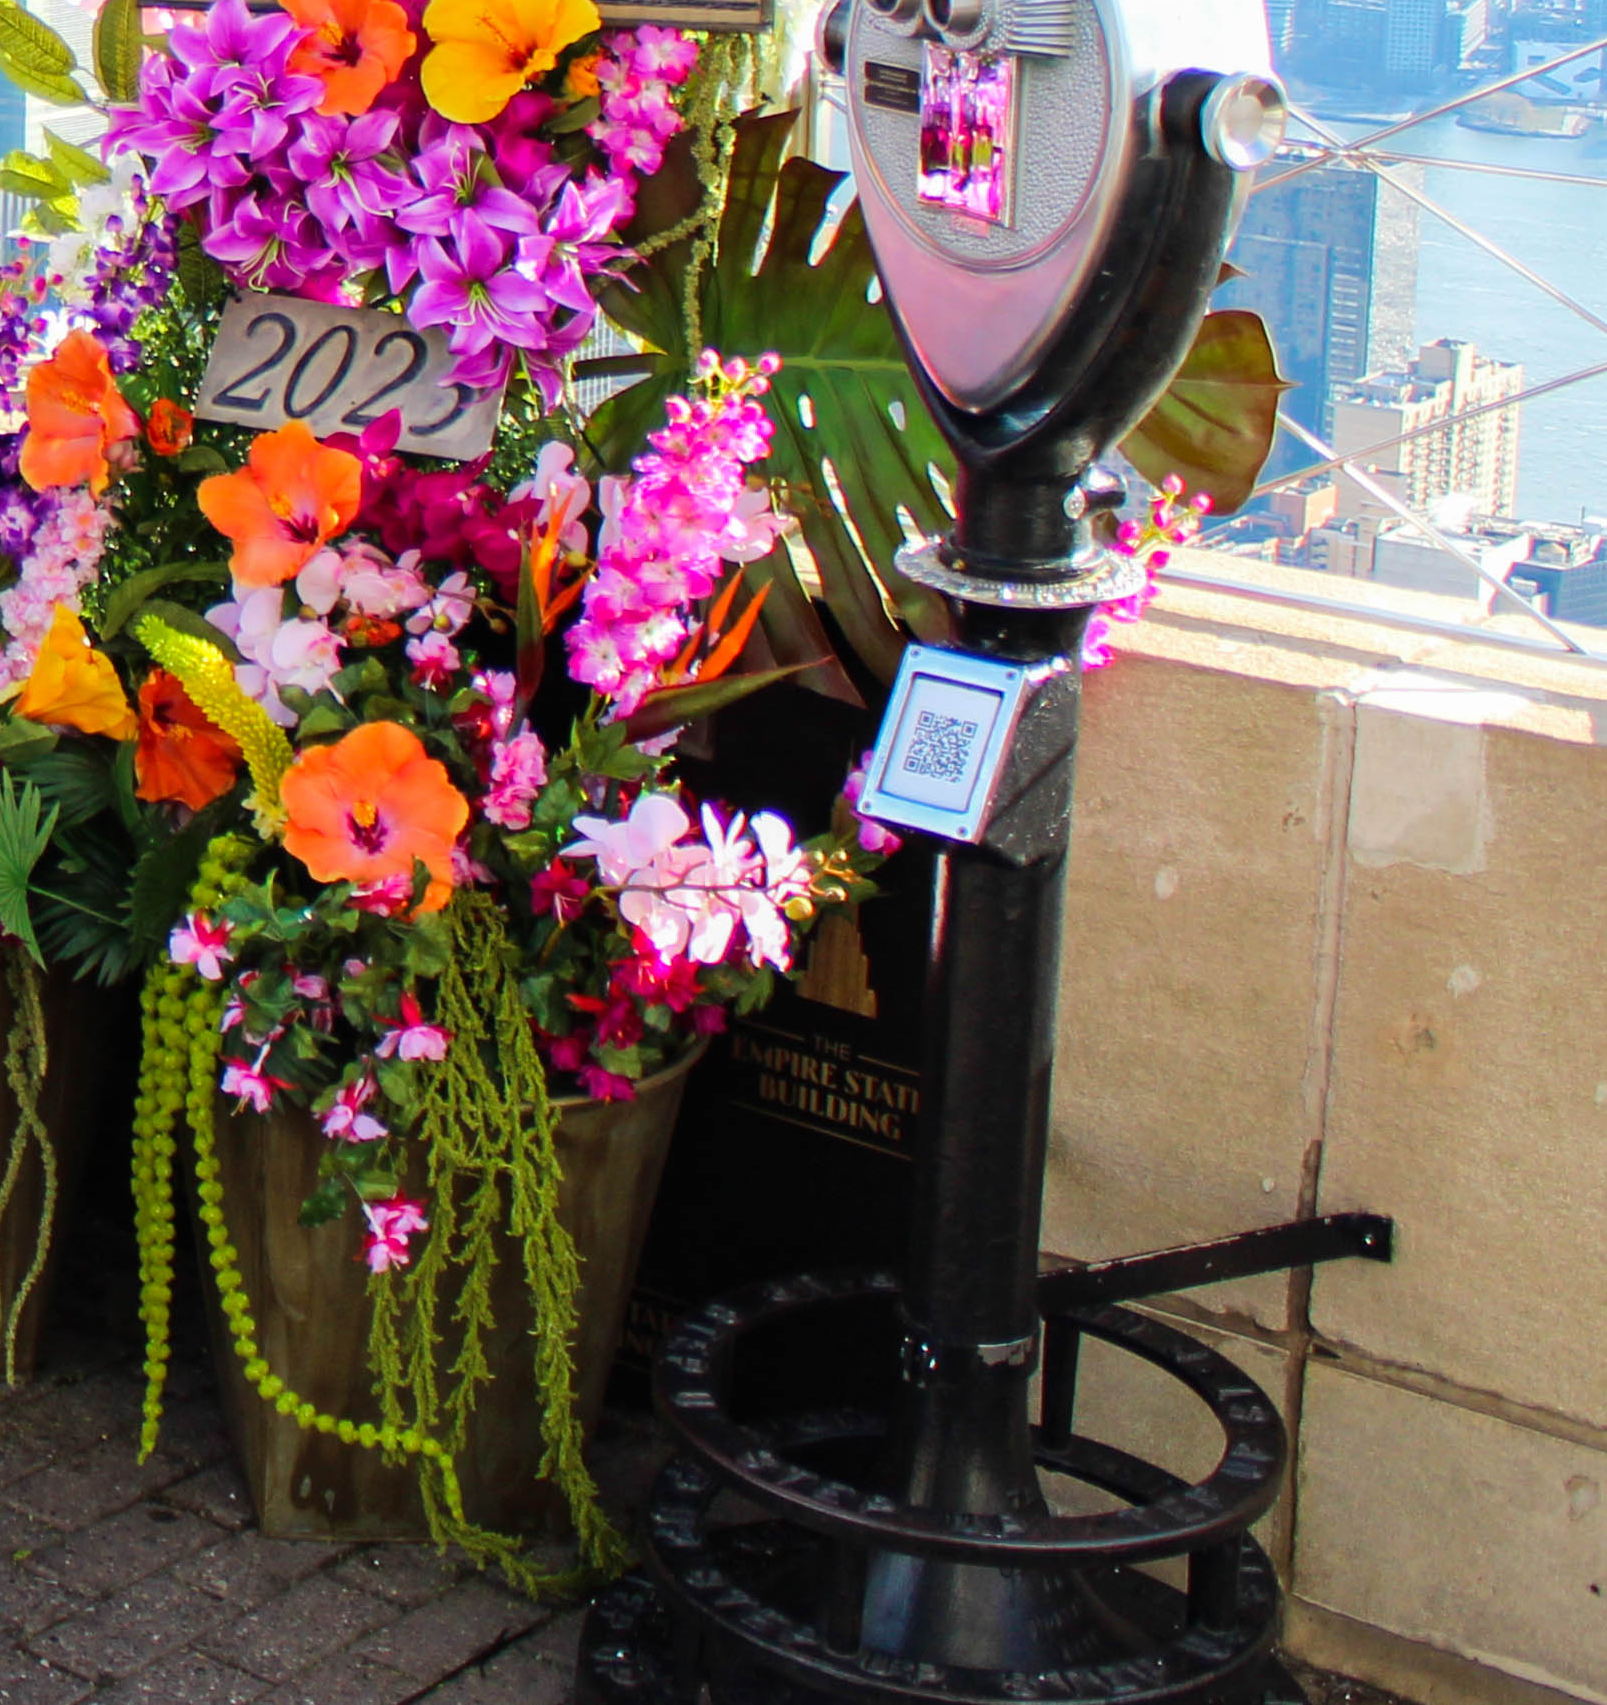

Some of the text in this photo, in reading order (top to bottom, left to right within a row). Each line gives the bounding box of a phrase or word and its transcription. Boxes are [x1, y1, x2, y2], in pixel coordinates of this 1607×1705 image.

[730, 1035, 840, 1091] EMPIRE
[812, 1032, 853, 1061] THE
[758, 1070, 904, 1142] BUILDING
